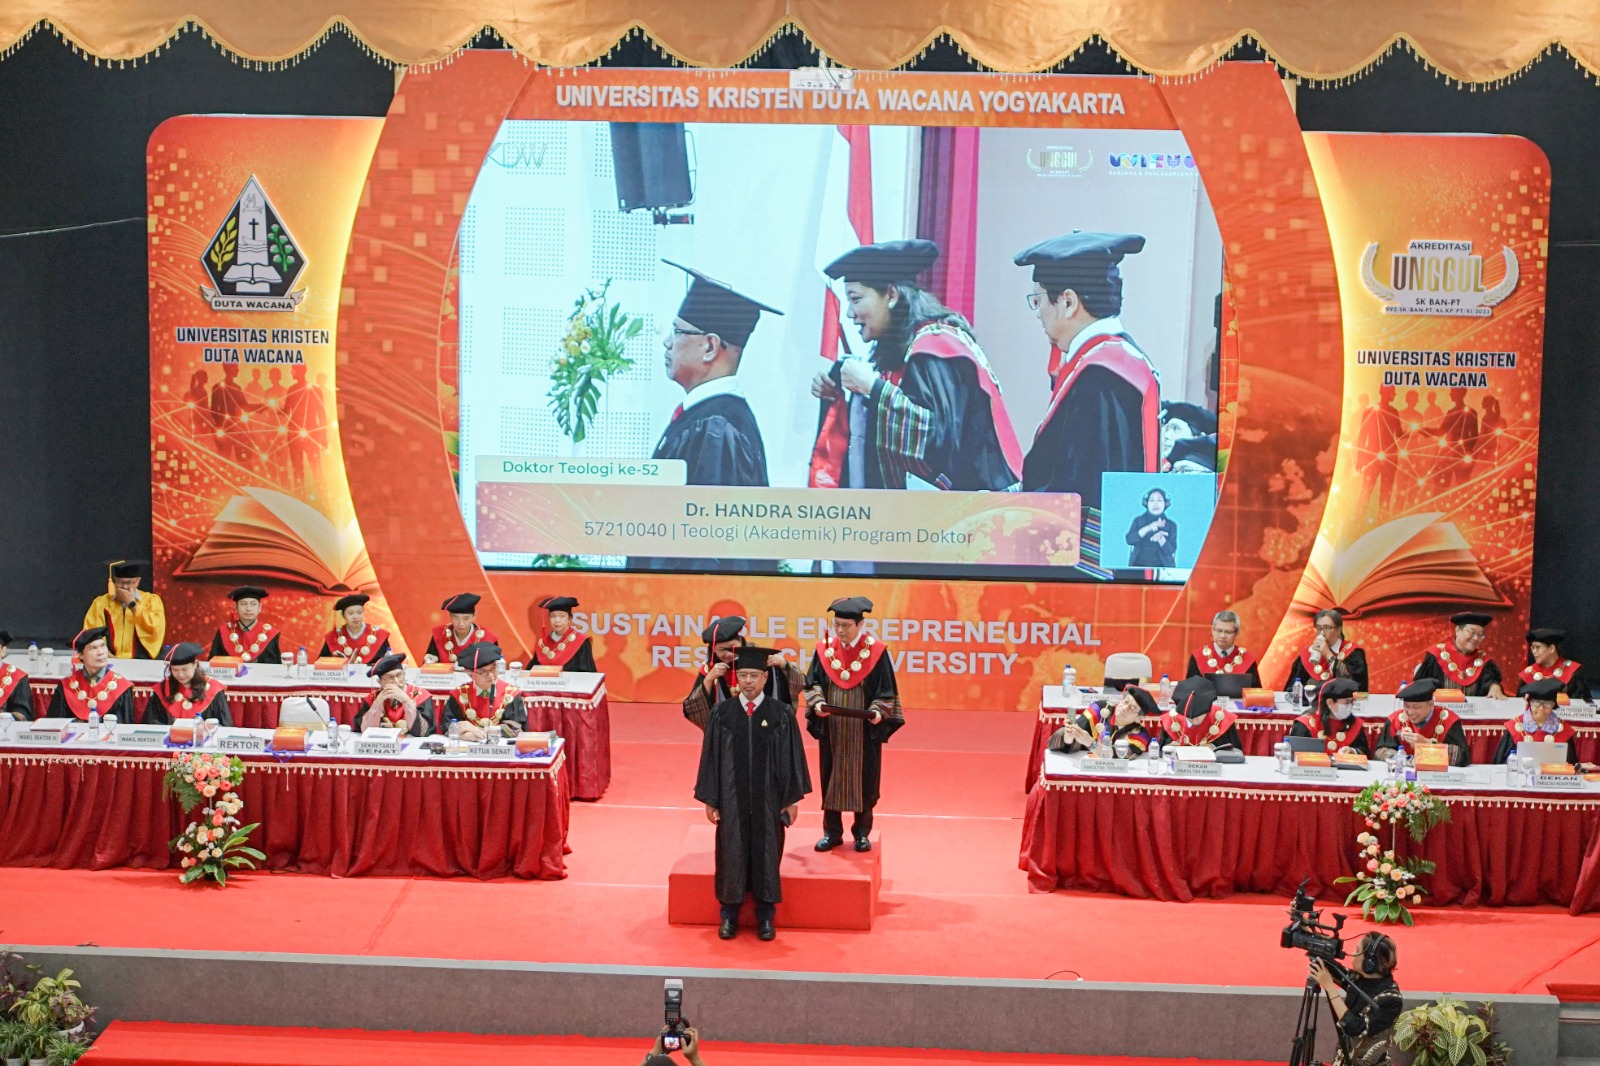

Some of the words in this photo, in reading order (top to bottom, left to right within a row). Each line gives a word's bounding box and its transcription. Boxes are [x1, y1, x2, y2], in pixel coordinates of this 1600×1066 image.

[556, 85, 699, 107] UNIVERSITAS
[708, 87, 804, 109] KRISTEN
[812, 89, 870, 110] DUTA
[878, 89, 974, 112] WACANA
[979, 90, 1125, 115] YOGYAKARTA
[1410, 242, 1471, 251] AKREDITASI
[1393, 256, 1485, 292] UNGGUL
[214, 300, 243, 308] DUTA
[246, 301, 293, 309] WACANA
[1415, 298, 1426, 306] SK
[1429, 298, 1461, 306] BAN-PT
[176, 327, 267, 343] UNIVERSITAS
[271, 329, 330, 344] KRISTEN
[204, 348, 239, 362] DUTA
[244, 349, 303, 363] WACANA
[1357, 350, 1451, 366] UNIVERSITAS
[1455, 352, 1516, 367] KRISTEN
[1384, 371, 1420, 386] DUTA
[1425, 372, 1487, 387] WACANA
[503, 461, 554, 474] Doktor
[558, 462, 613, 477] Teologi
[618, 463, 659, 476] ke-52
[685, 503, 709, 517] Dr.
[715, 503, 793, 519] HANDRA
[797, 505, 871, 520] SIAGIAN
[584, 522, 667, 537] 57210040
[681, 523, 739, 541] Teologi
[743, 524, 837, 543] (Akademik)
[842, 527, 911, 545] Program
[917, 529, 973, 544] Doktor
[571, 611, 788, 639] SUSTAINLE
[797, 616, 1101, 646] ENREPRENEURIAL
[220, 740, 259, 749] REKTOR
